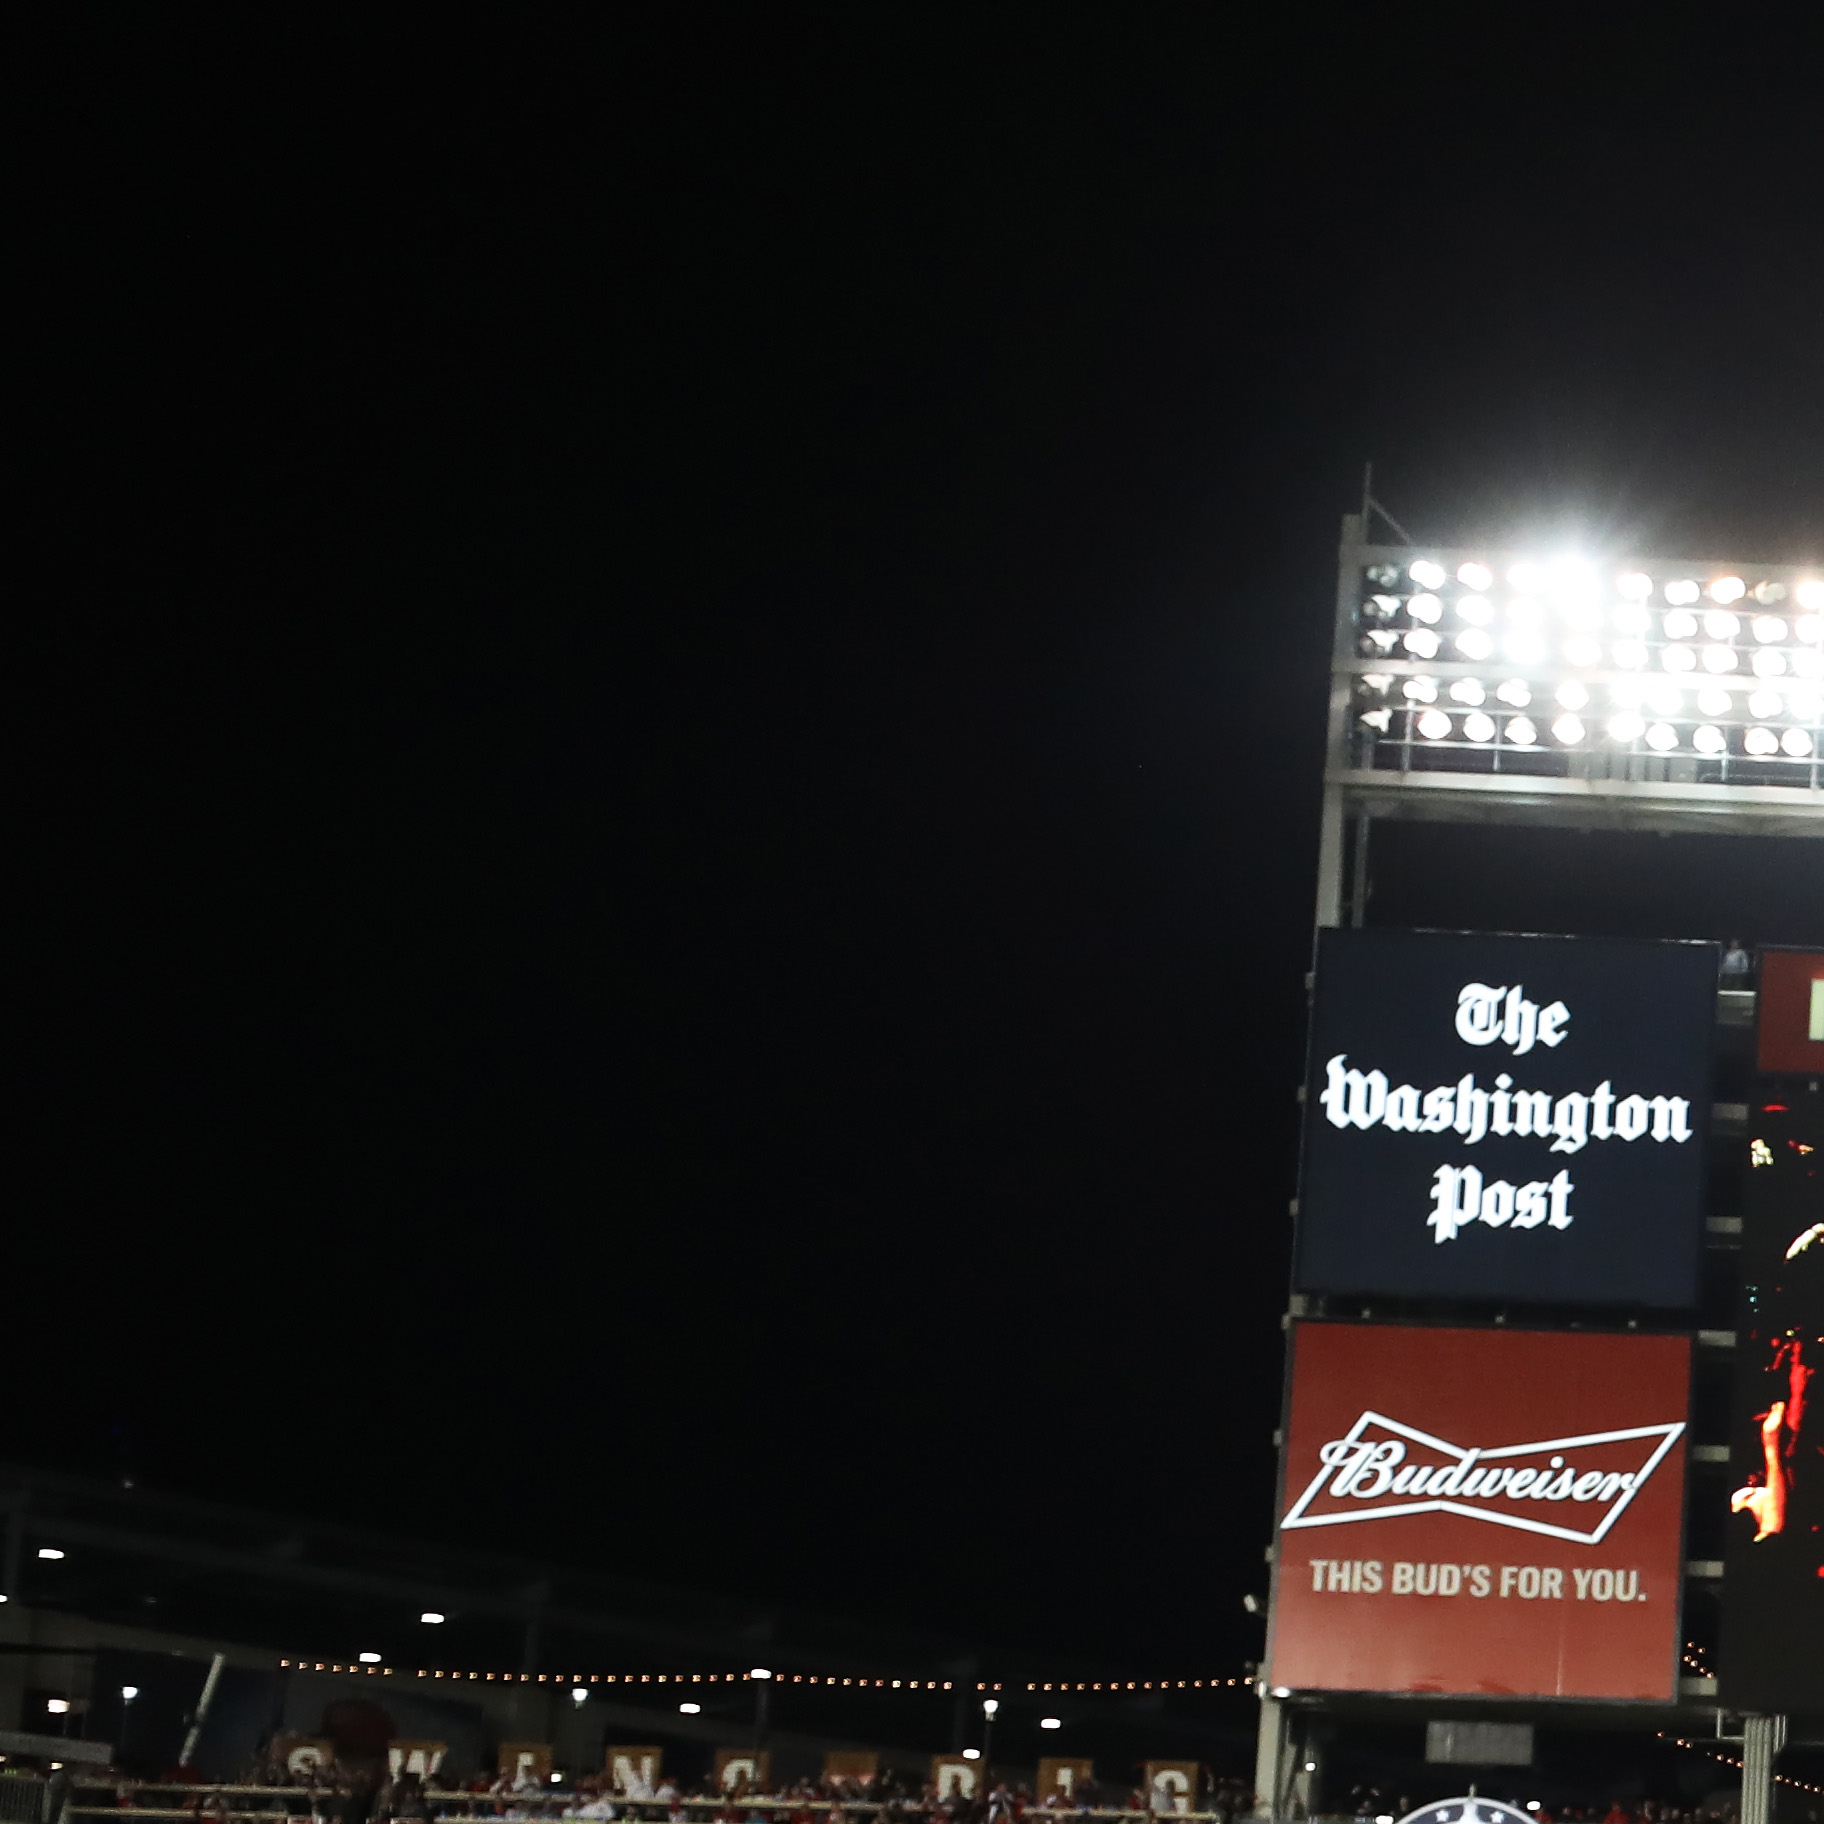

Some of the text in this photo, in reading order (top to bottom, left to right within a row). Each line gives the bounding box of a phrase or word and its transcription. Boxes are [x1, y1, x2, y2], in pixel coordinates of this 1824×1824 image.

[1454, 982, 1571, 1056] The
[1320, 1053, 1693, 1155] Washington
[1427, 1165, 1575, 1243] Post
[1319, 1440, 1638, 1502] Budweiser
[1309, 1560, 1647, 1602] THIS BUD'S FOR YOU.
